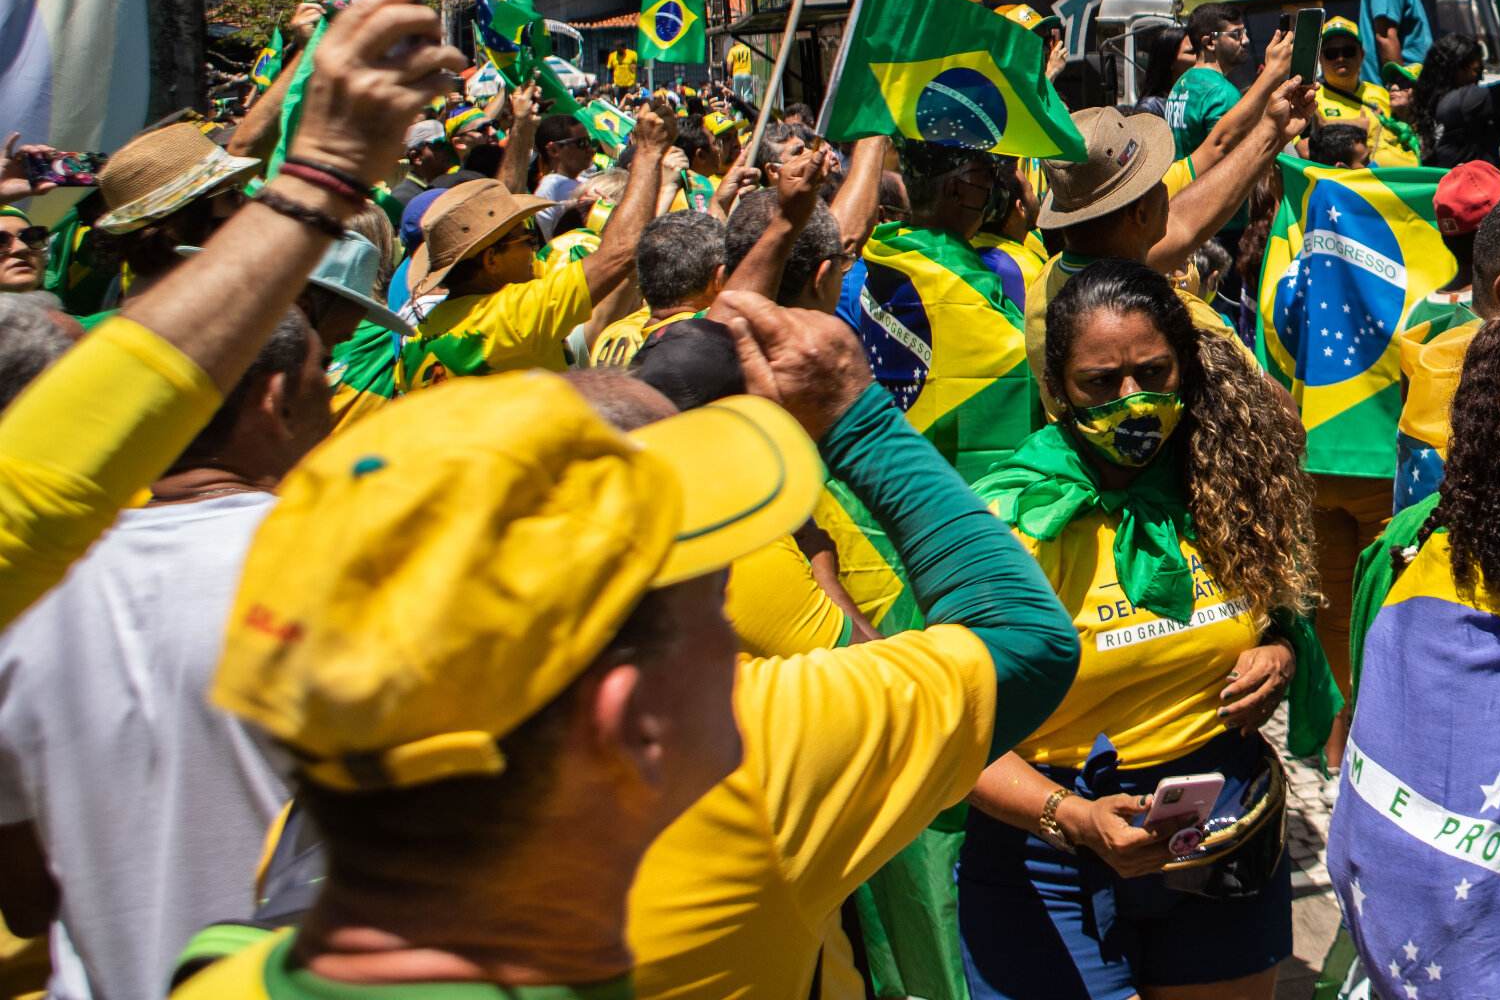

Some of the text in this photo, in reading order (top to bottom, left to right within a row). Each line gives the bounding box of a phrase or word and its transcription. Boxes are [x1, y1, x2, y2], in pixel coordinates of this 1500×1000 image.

[1313, 234, 1396, 280] ROGRESSO
[1105, 630, 1132, 647] RIO
[1197, 608, 1216, 625] DO
[1389, 786, 1411, 818] E
